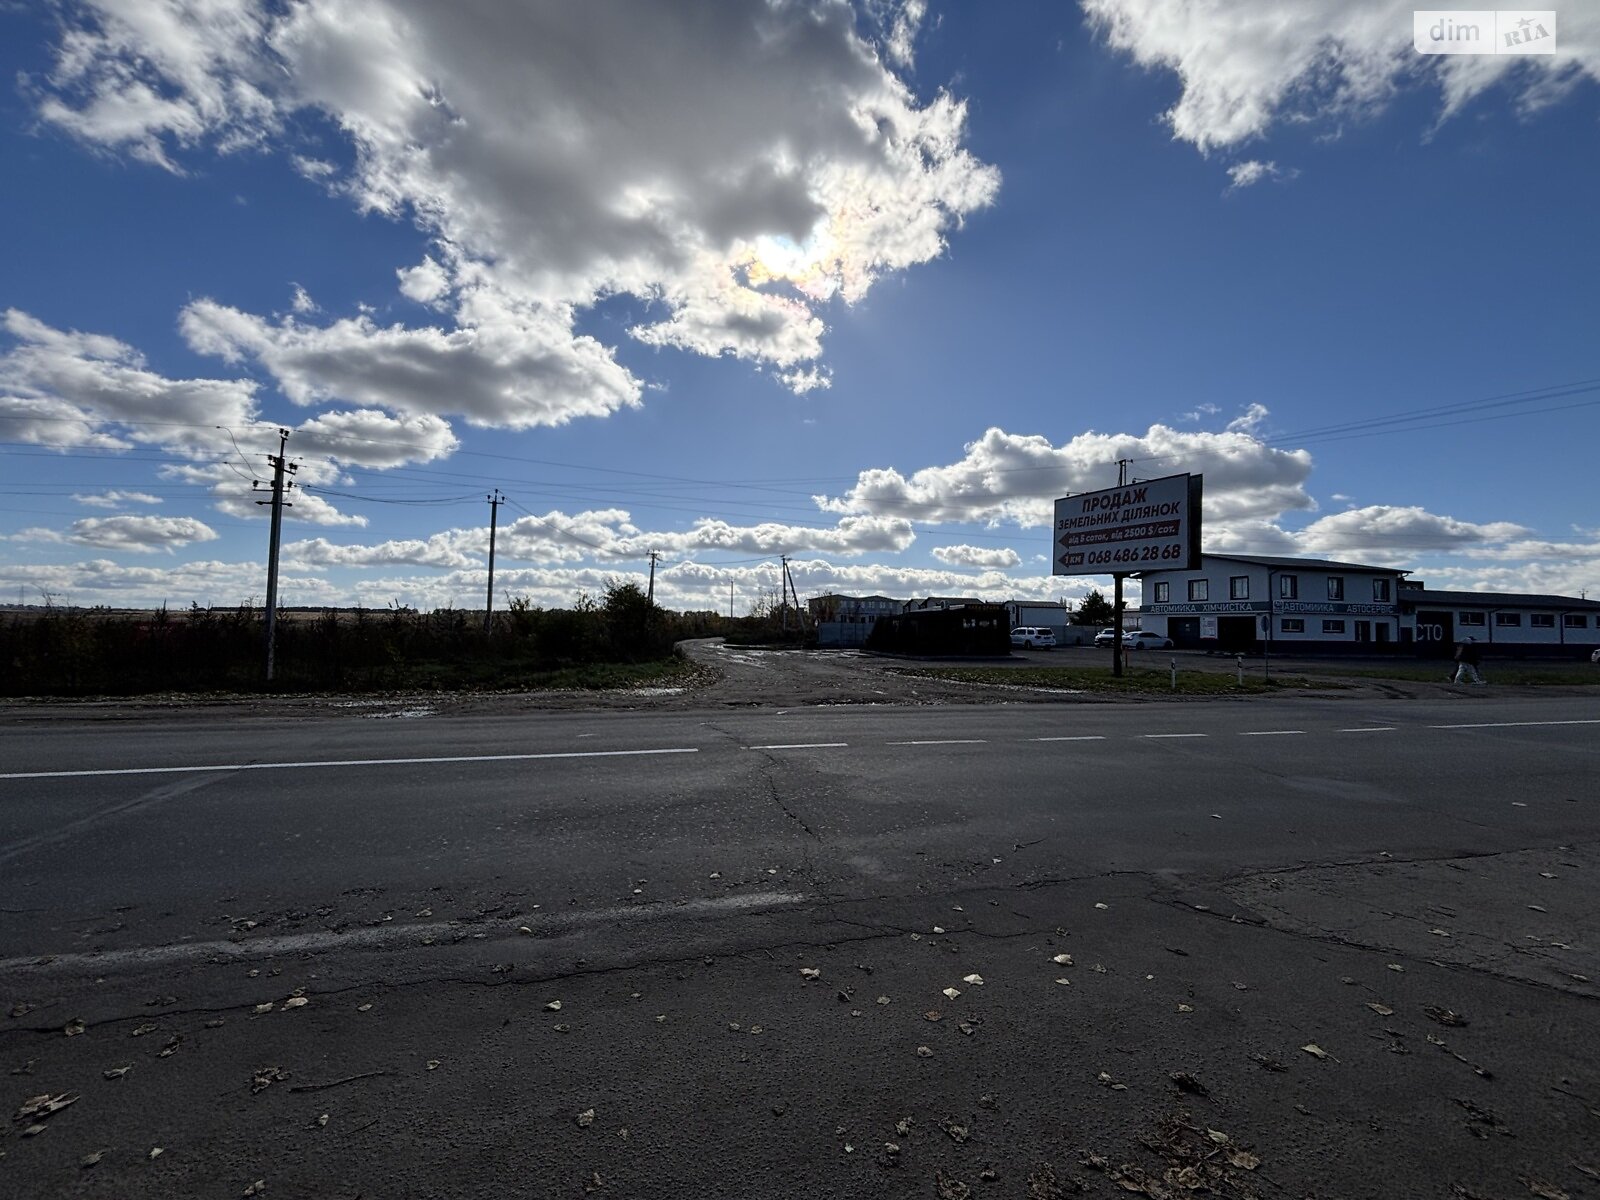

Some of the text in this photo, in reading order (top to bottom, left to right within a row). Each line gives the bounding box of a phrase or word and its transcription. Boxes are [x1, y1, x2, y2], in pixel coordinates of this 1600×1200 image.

[1082, 487, 1149, 513] ПРОДАЖ
[1058, 501, 1181, 530] ЗЕМЕЛЬНИХ ДІЛЯНОК
[1080, 534, 1085, 543] 5
[1124, 527, 1147, 538] 2500
[1088, 543, 1181, 565] 068 486 28 68
[1150, 602, 1253, 613] АВТОМИЙКА ХІМЧИСТКА
[1346, 604, 1394, 614] АВТОСЕРВІС
